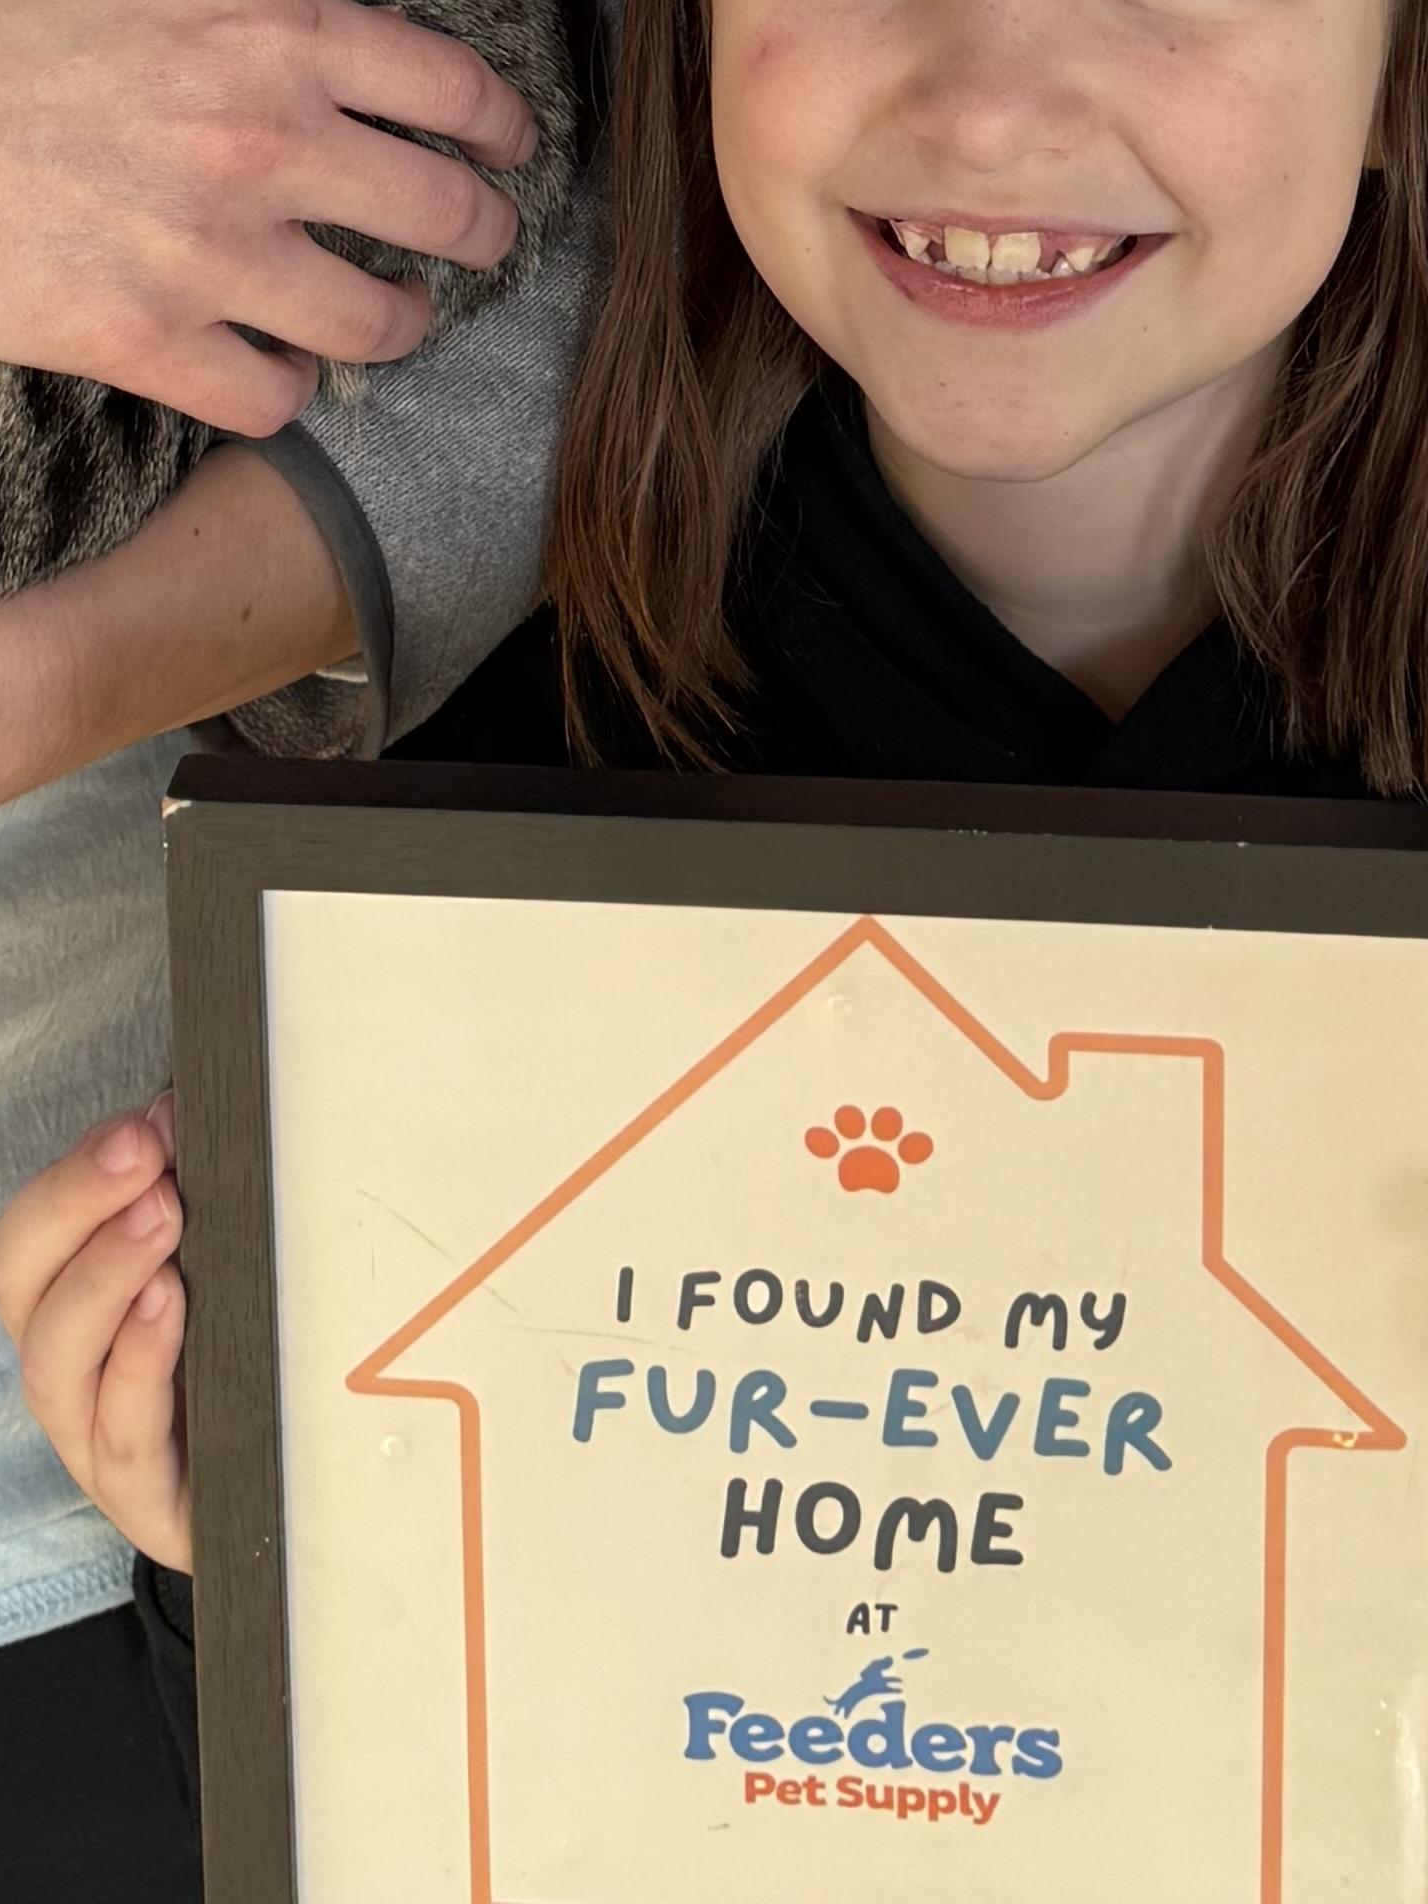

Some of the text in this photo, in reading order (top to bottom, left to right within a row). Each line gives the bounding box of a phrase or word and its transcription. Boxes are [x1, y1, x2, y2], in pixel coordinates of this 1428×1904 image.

[616, 1266, 634, 1323] I
[677, 1268, 961, 1343] FOUND
[572, 1358, 1172, 1476] FUR-EVER
[720, 1477, 1025, 1573] HOME
[846, 1602, 899, 1635] AT
[683, 1691, 1063, 1779] Feeders
[744, 1772, 1001, 1825] Pet Supply
